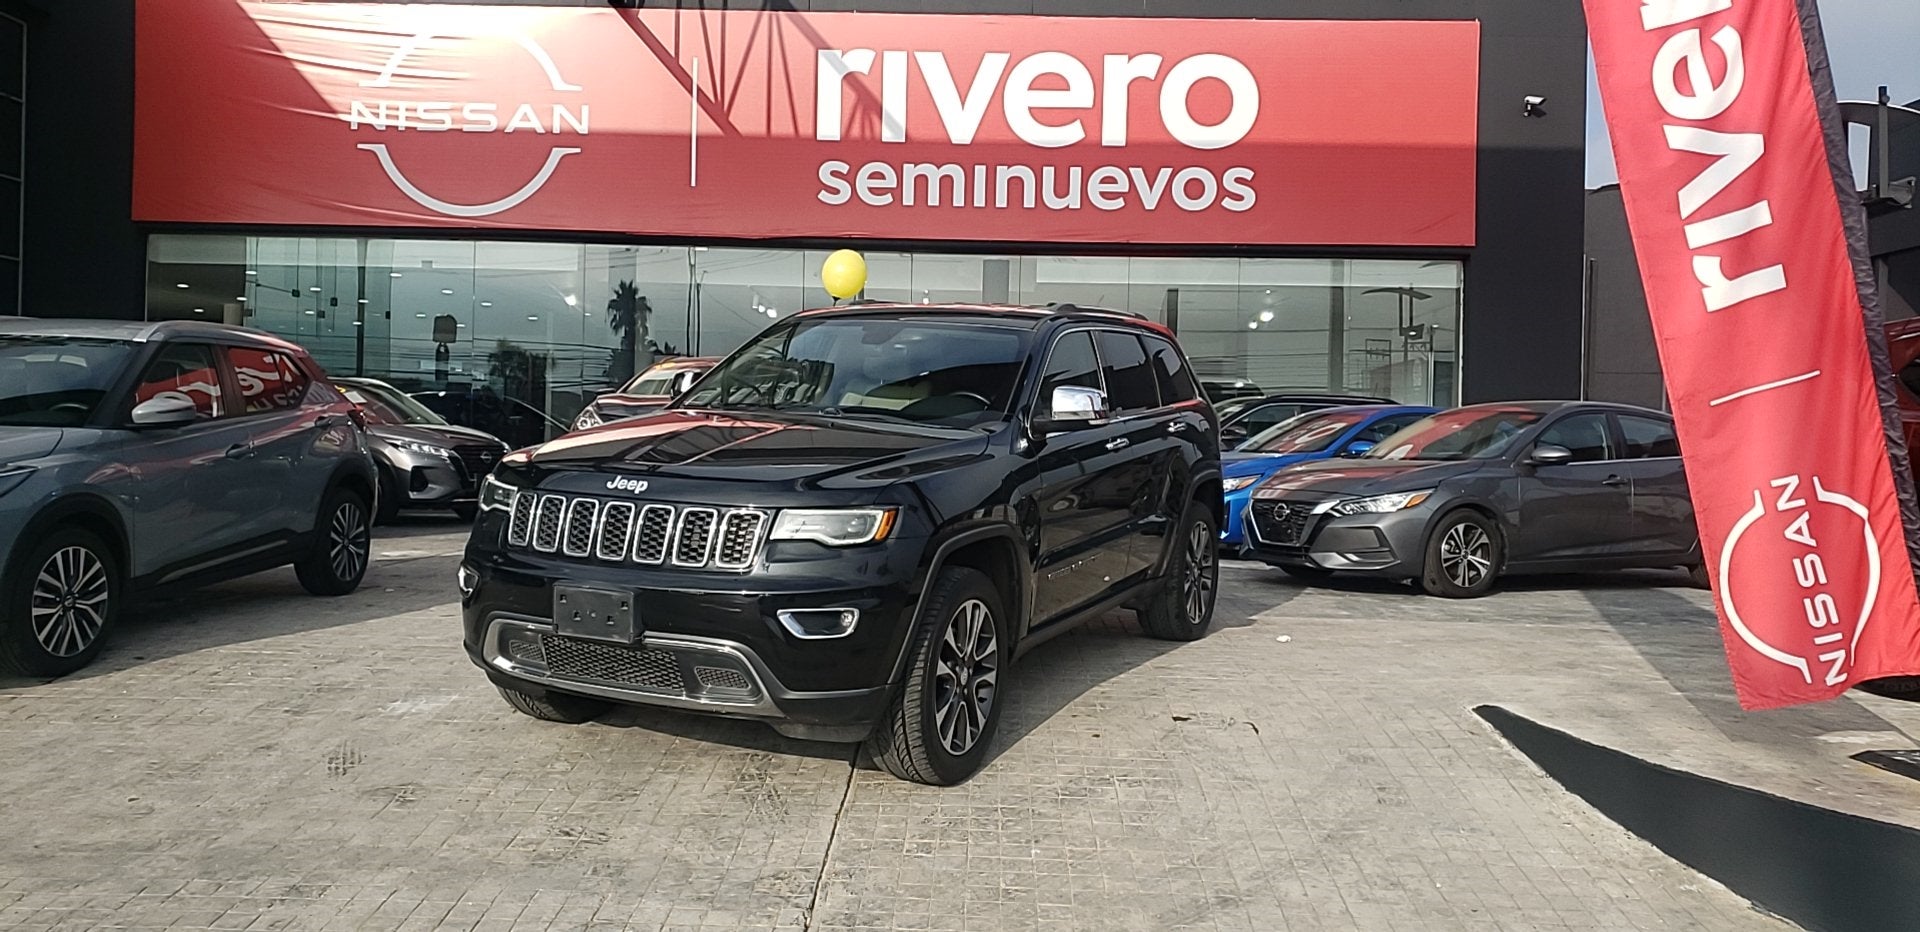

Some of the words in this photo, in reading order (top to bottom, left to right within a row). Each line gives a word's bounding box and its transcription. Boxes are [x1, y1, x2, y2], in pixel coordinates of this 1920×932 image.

[349, 102, 590, 135] NISSAN
[816, 47, 1261, 150] rivero
[816, 159, 1257, 212] seminuevos
[606, 475, 649, 495] Jeep
[1770, 474, 1848, 687] NISSAN
